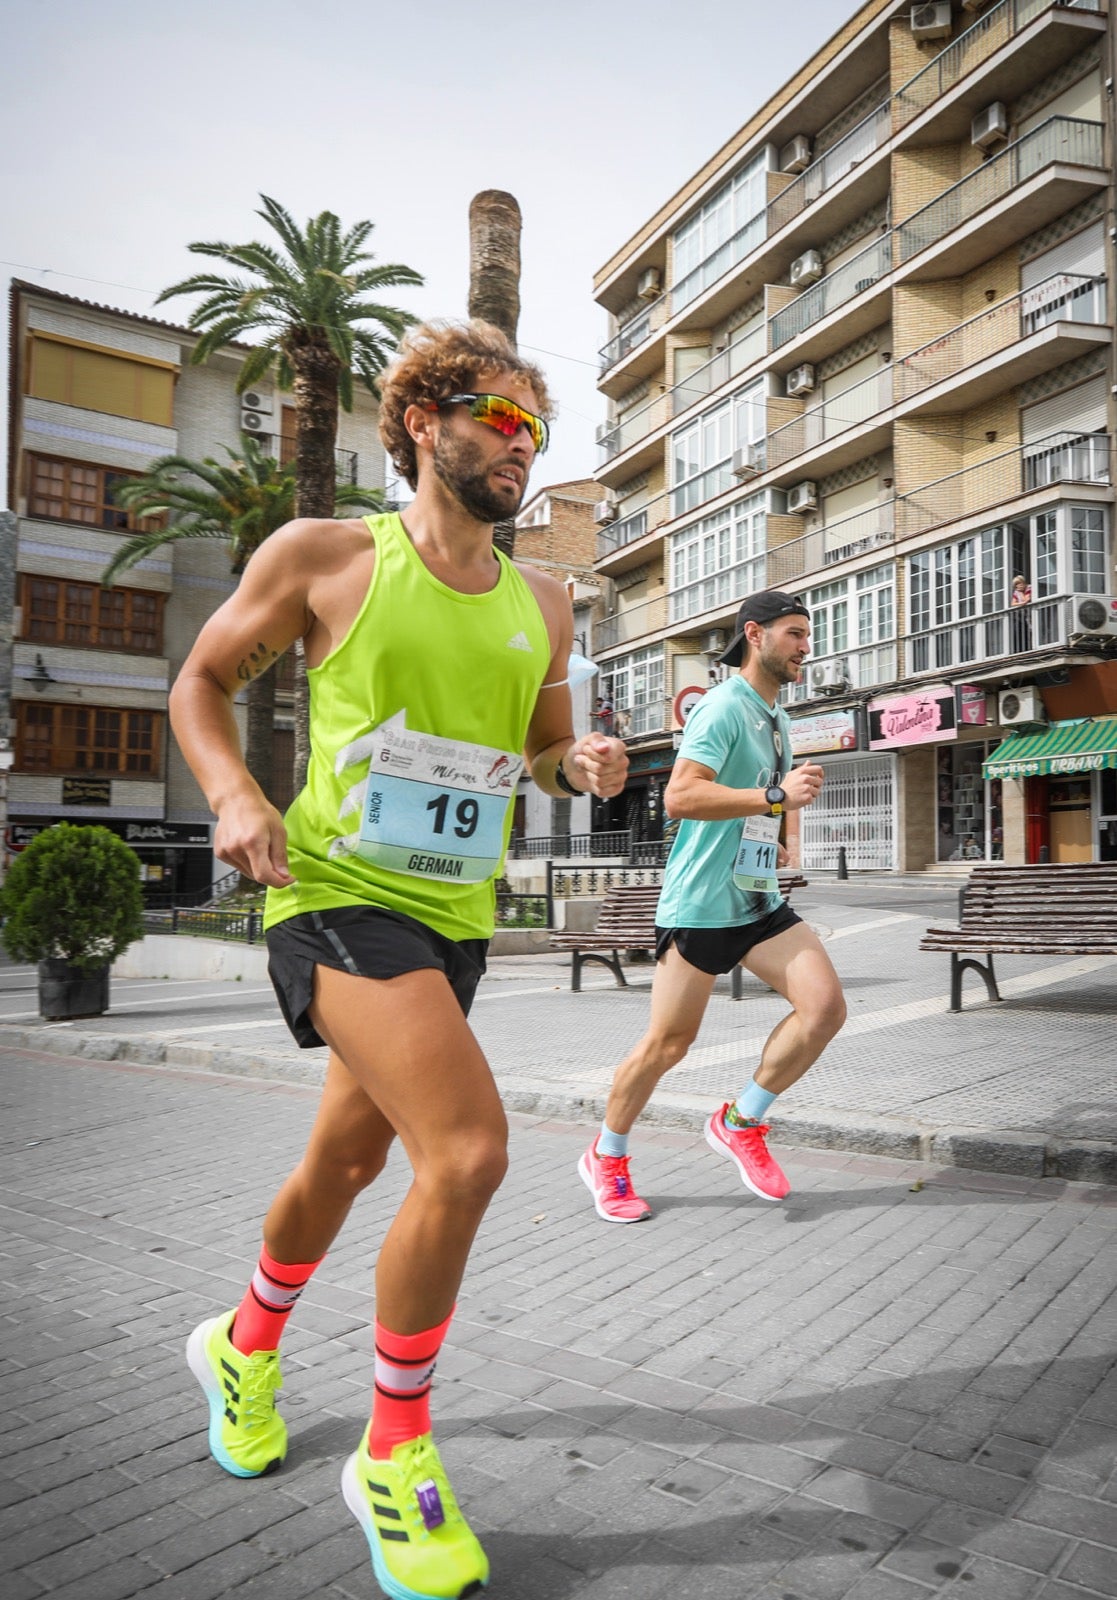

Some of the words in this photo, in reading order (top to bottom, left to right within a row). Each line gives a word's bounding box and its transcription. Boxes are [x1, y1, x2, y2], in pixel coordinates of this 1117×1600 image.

[1050, 755, 1104, 772] URBANO
[368, 791, 383, 824] SENIOR
[426, 793, 479, 838] 19
[407, 854, 464, 877] GERMAN
